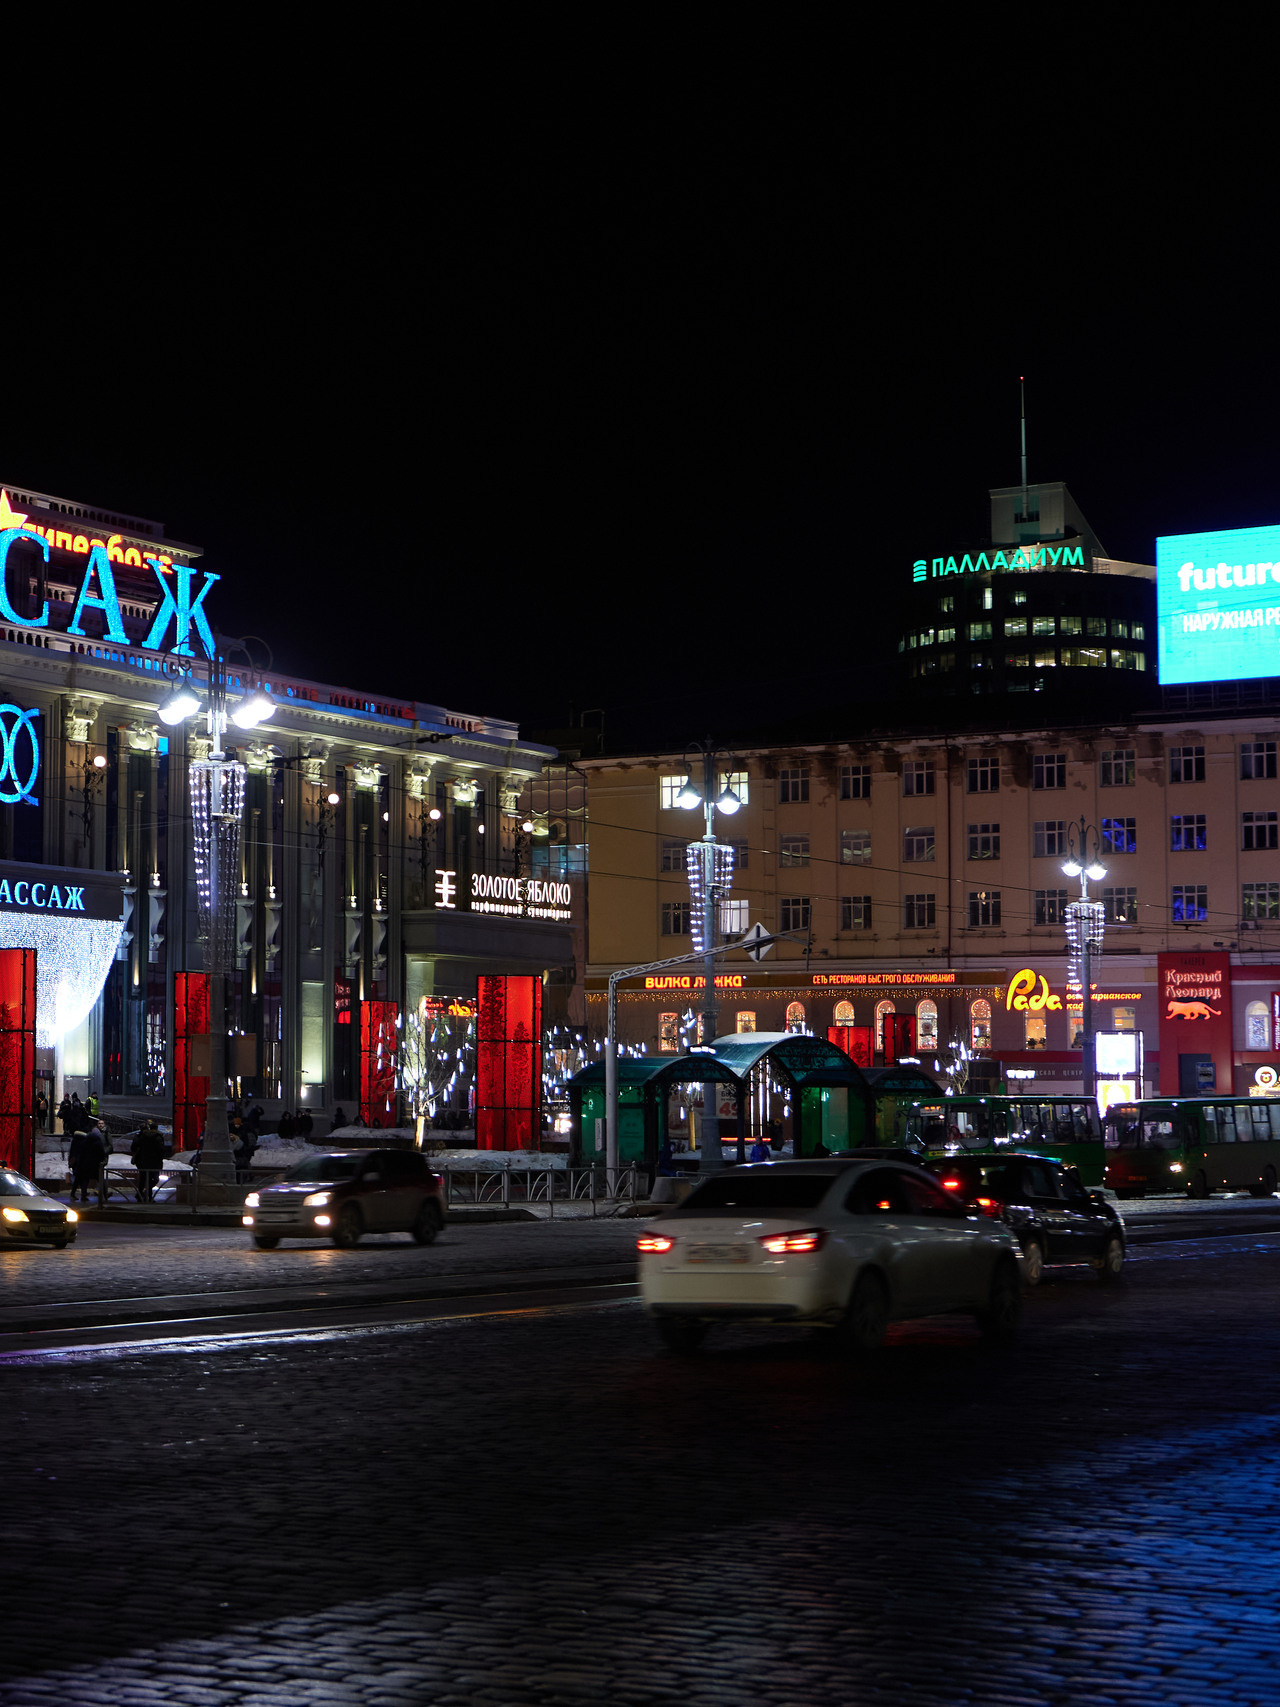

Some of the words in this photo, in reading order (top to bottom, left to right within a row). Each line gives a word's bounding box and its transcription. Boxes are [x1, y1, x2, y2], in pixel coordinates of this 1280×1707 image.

[932, 546, 1085, 578] ПАЛЛАДИУМ
[1183, 609, 1263, 633] НАРУЖНАЯ
[471, 873, 523, 901] ЗОЛОТОЕ
[526, 880, 571, 905] ЯБЛОКО
[645, 976, 690, 989] вилка
[693, 975, 742, 988] лжка
[812, 975, 828, 984] СЕТЬ
[828, 974, 867, 984] РЕСТОРАНОВ
[902, 973, 956, 983] ОБСЛУЖИВАНИЯ
[1165, 968, 1222, 986] Красный
[1006, 968, 1063, 1011] Рада
[1165, 985, 1222, 1000] Леопард
